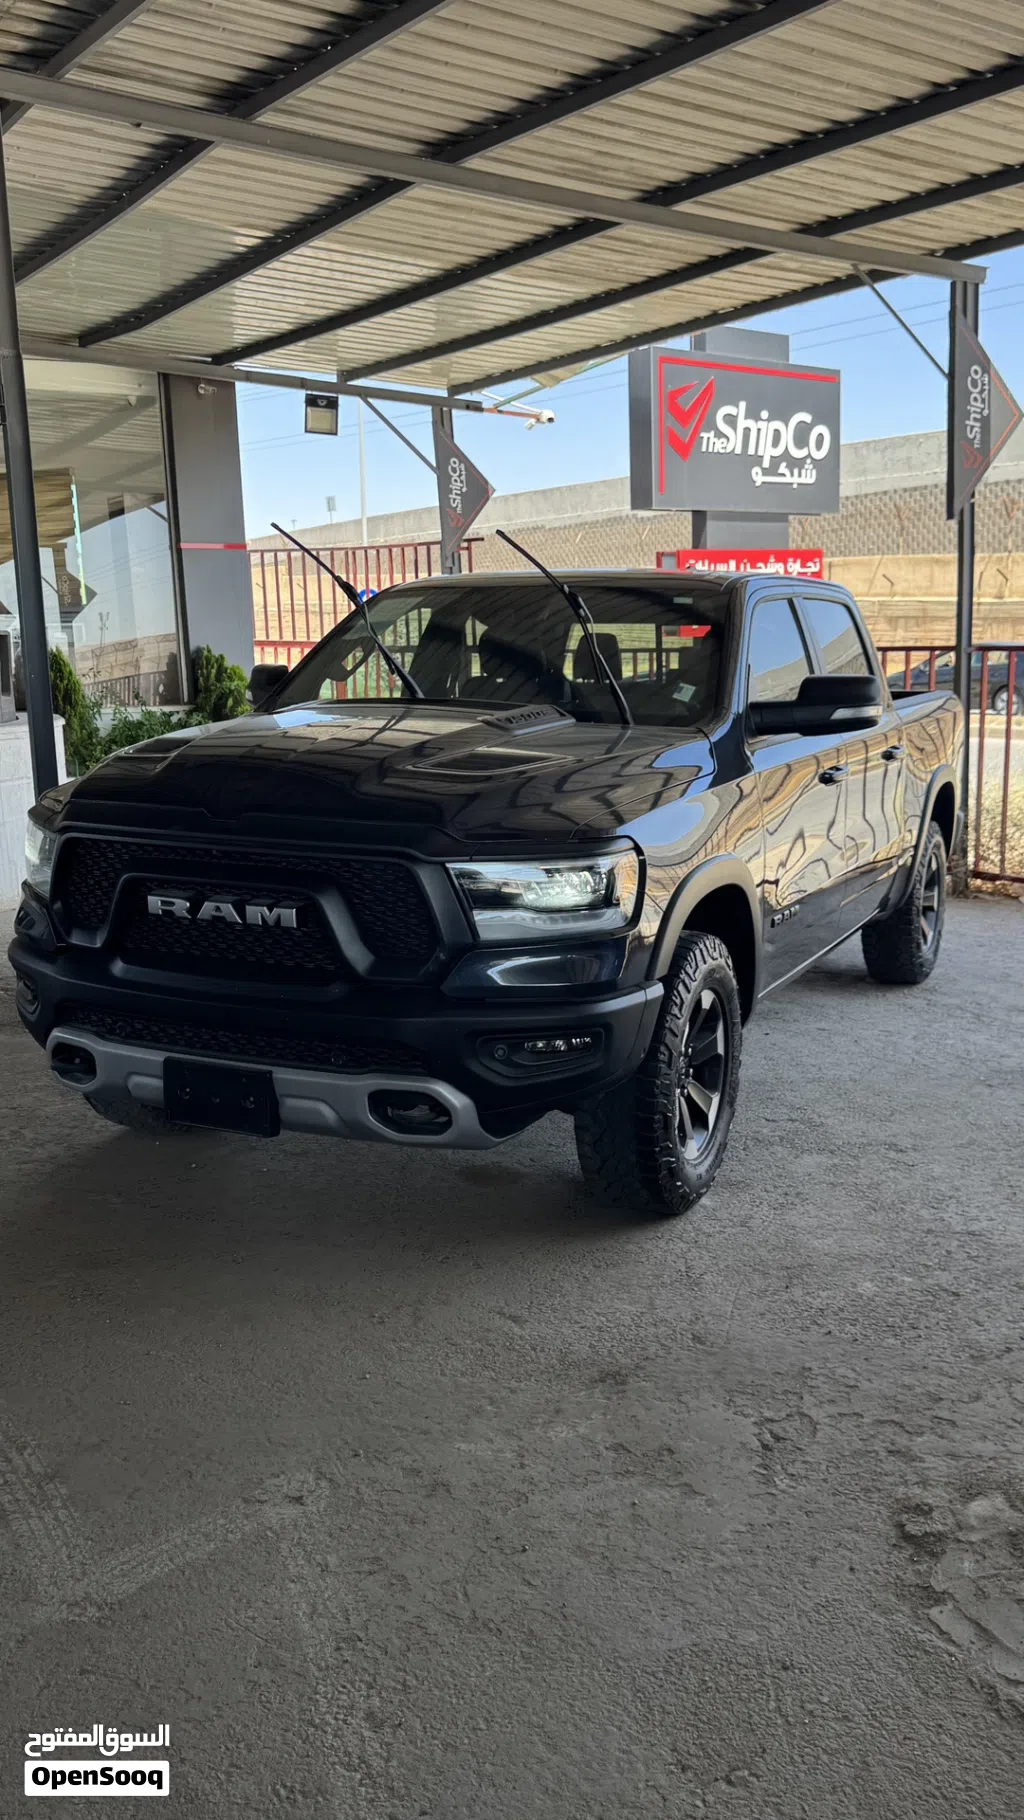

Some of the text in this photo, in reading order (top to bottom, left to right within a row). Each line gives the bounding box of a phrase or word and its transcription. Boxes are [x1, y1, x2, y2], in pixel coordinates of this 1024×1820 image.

[751, 458, 817, 489] شبكو
[786, 557, 821, 576] تجارة
[147, 894, 298, 929] RAM
